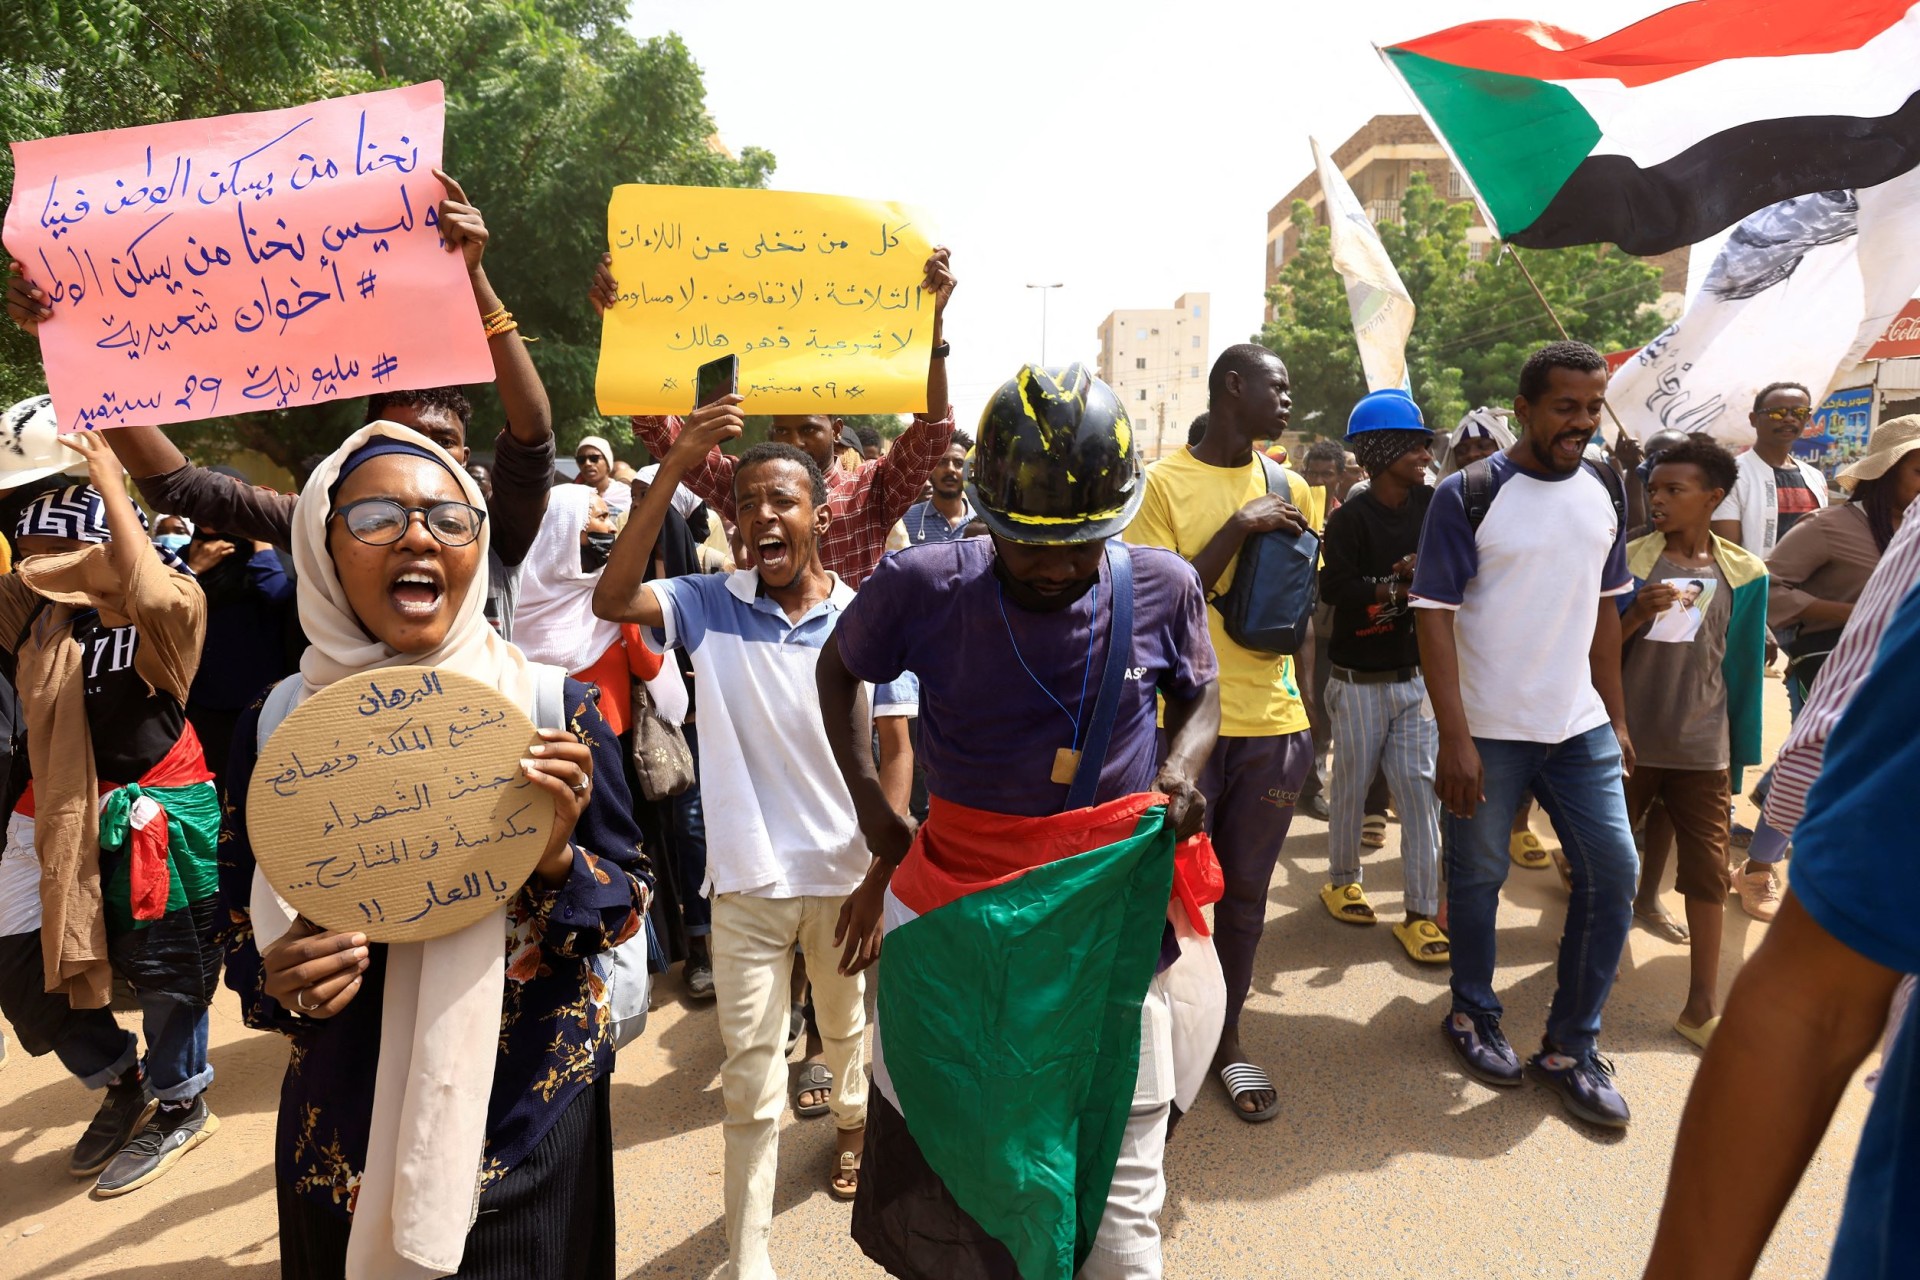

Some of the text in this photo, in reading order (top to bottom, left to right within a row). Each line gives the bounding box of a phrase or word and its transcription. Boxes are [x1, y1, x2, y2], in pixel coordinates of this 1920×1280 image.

[39, 110, 418, 239] نحنا من يسكن الوطن فينا
[183, 228, 232, 277] من
[237, 200, 306, 265] نحنا
[692, 235, 730, 261] عن
[817, 232, 848, 255] من
[870, 222, 911, 256] كل
[111, 212, 182, 298] يسكن
[47, 245, 104, 309] الوط
[611, 280, 675, 309] مساوم
[72, 391, 161, 431] سبتمبر
[174, 374, 223, 413] 29
[358, 670, 444, 717] البرهان
